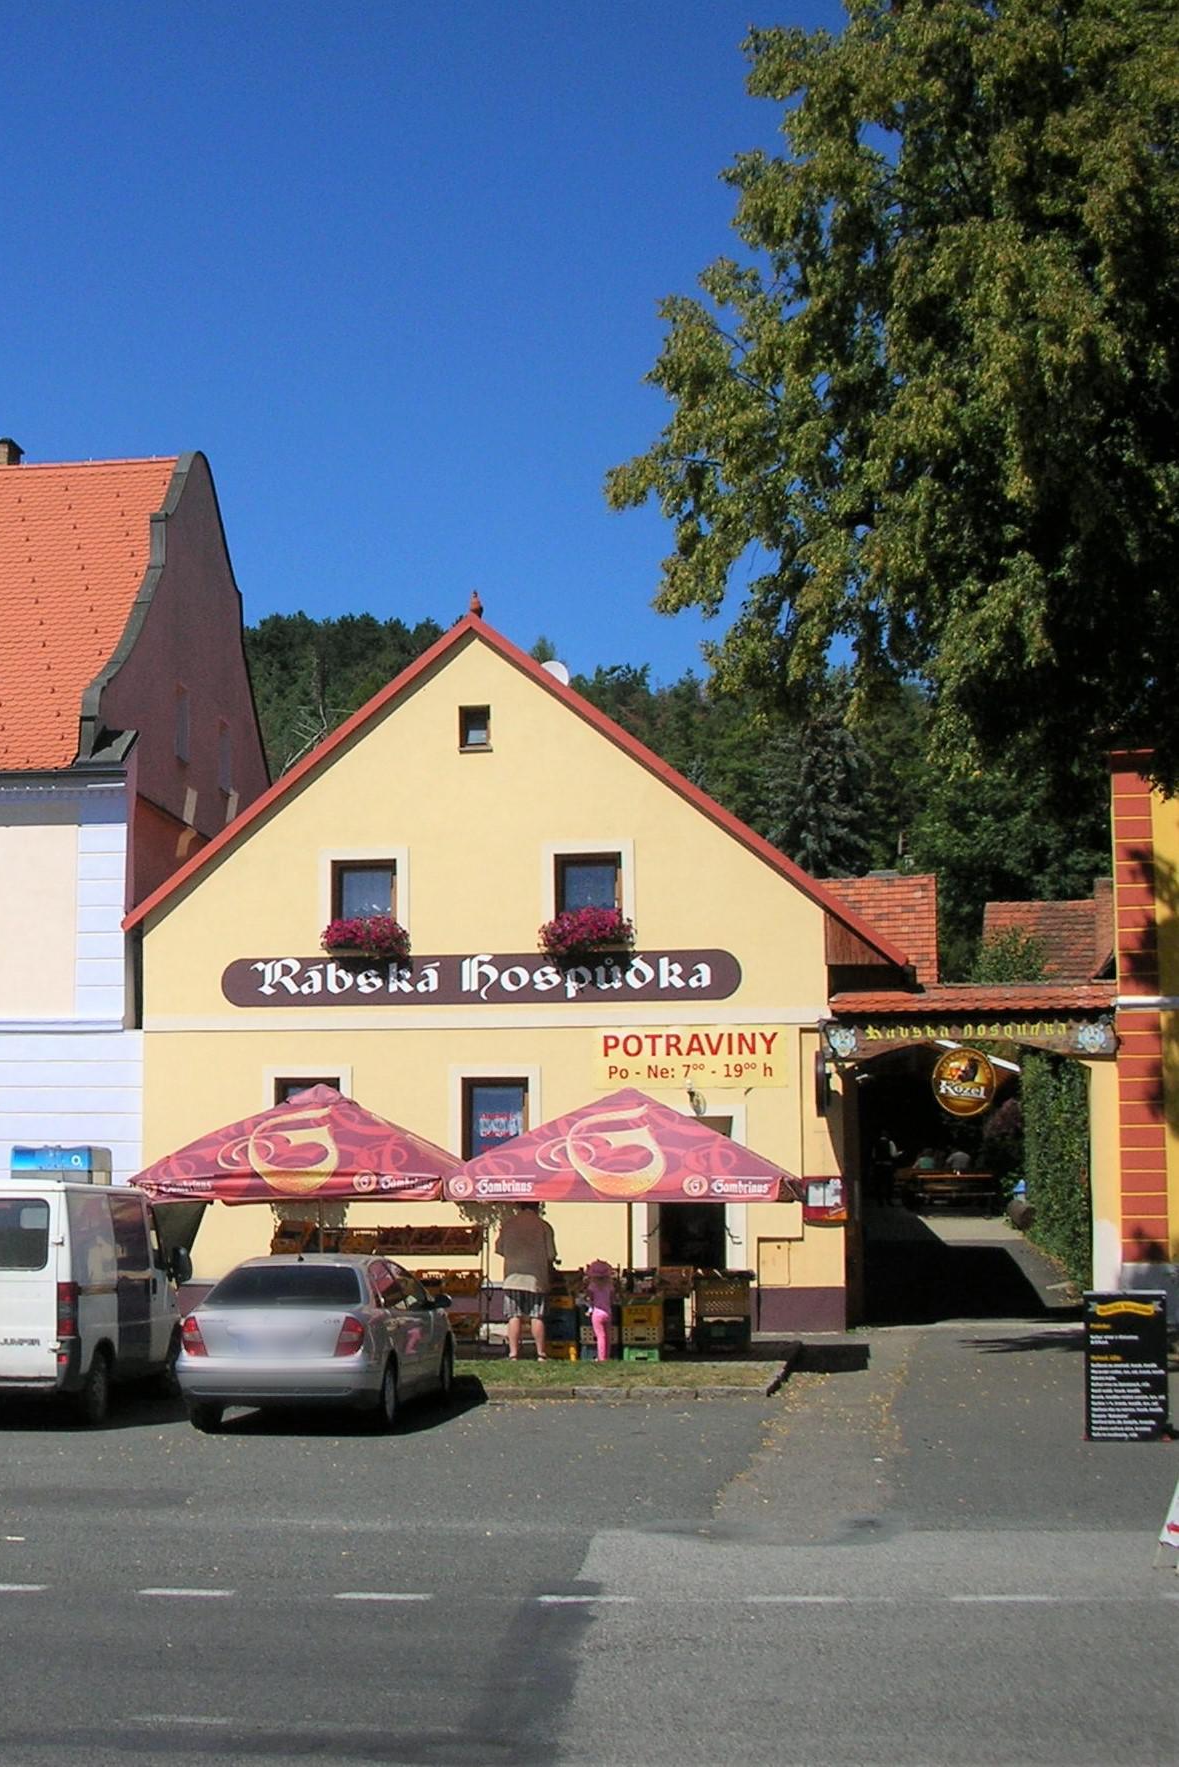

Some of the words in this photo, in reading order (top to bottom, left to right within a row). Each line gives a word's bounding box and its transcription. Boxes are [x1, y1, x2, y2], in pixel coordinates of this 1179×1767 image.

[603, 1032, 778, 1057] POTRAVINY
[609, 1066, 629, 1079] Po
[648, 1065, 674, 1079] Ne:
[764, 1063, 773, 1077] h
[476, 1179, 533, 1194] Gambrinus
[711, 1179, 770, 1194] Gambrinus
